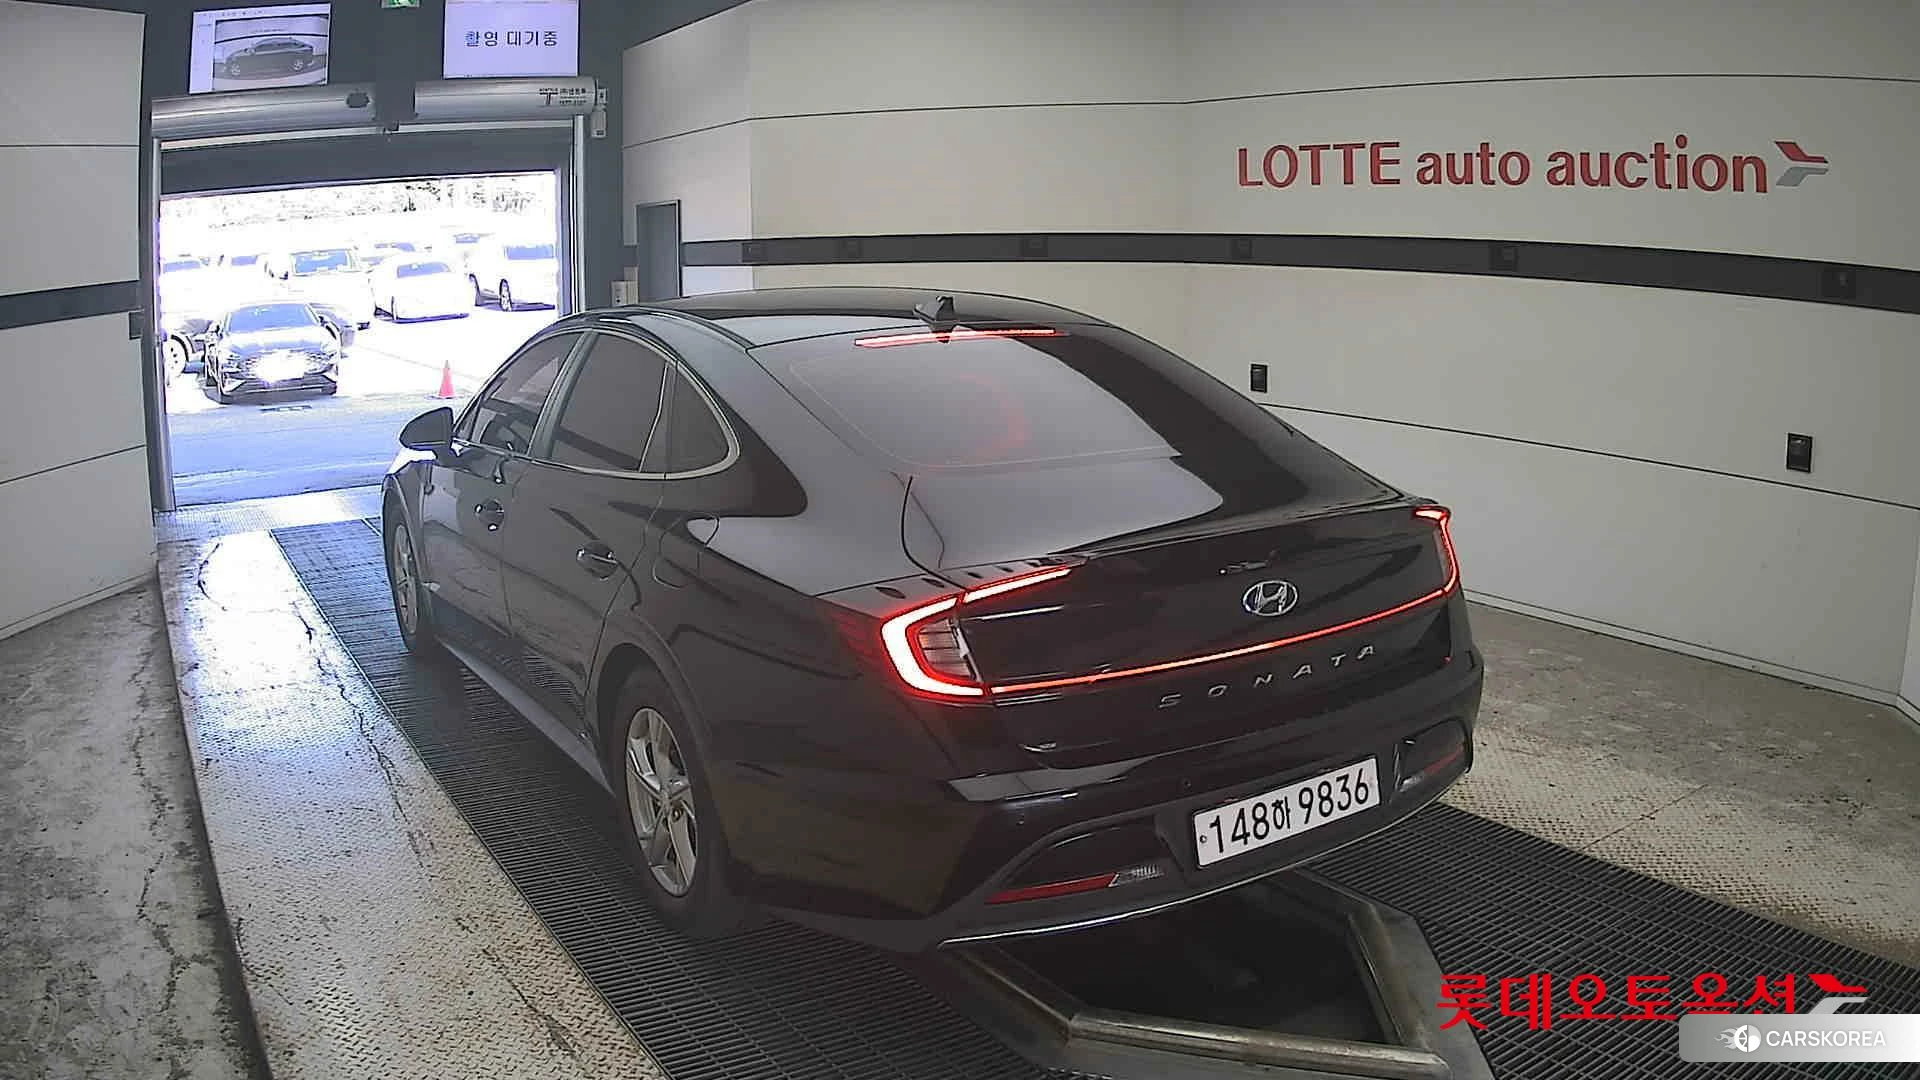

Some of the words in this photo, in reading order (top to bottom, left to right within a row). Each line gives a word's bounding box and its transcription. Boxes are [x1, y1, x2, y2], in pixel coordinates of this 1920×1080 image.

[507, 31, 558, 47] 대기중
[1238, 141, 1401, 188] LOTTE
[1416, 142, 1531, 186] auto
[1546, 134, 1768, 194] auction
[1159, 645, 1374, 708] SONATA
[1209, 796, 1290, 854] 148하
[1298, 768, 1369, 824] 9836
